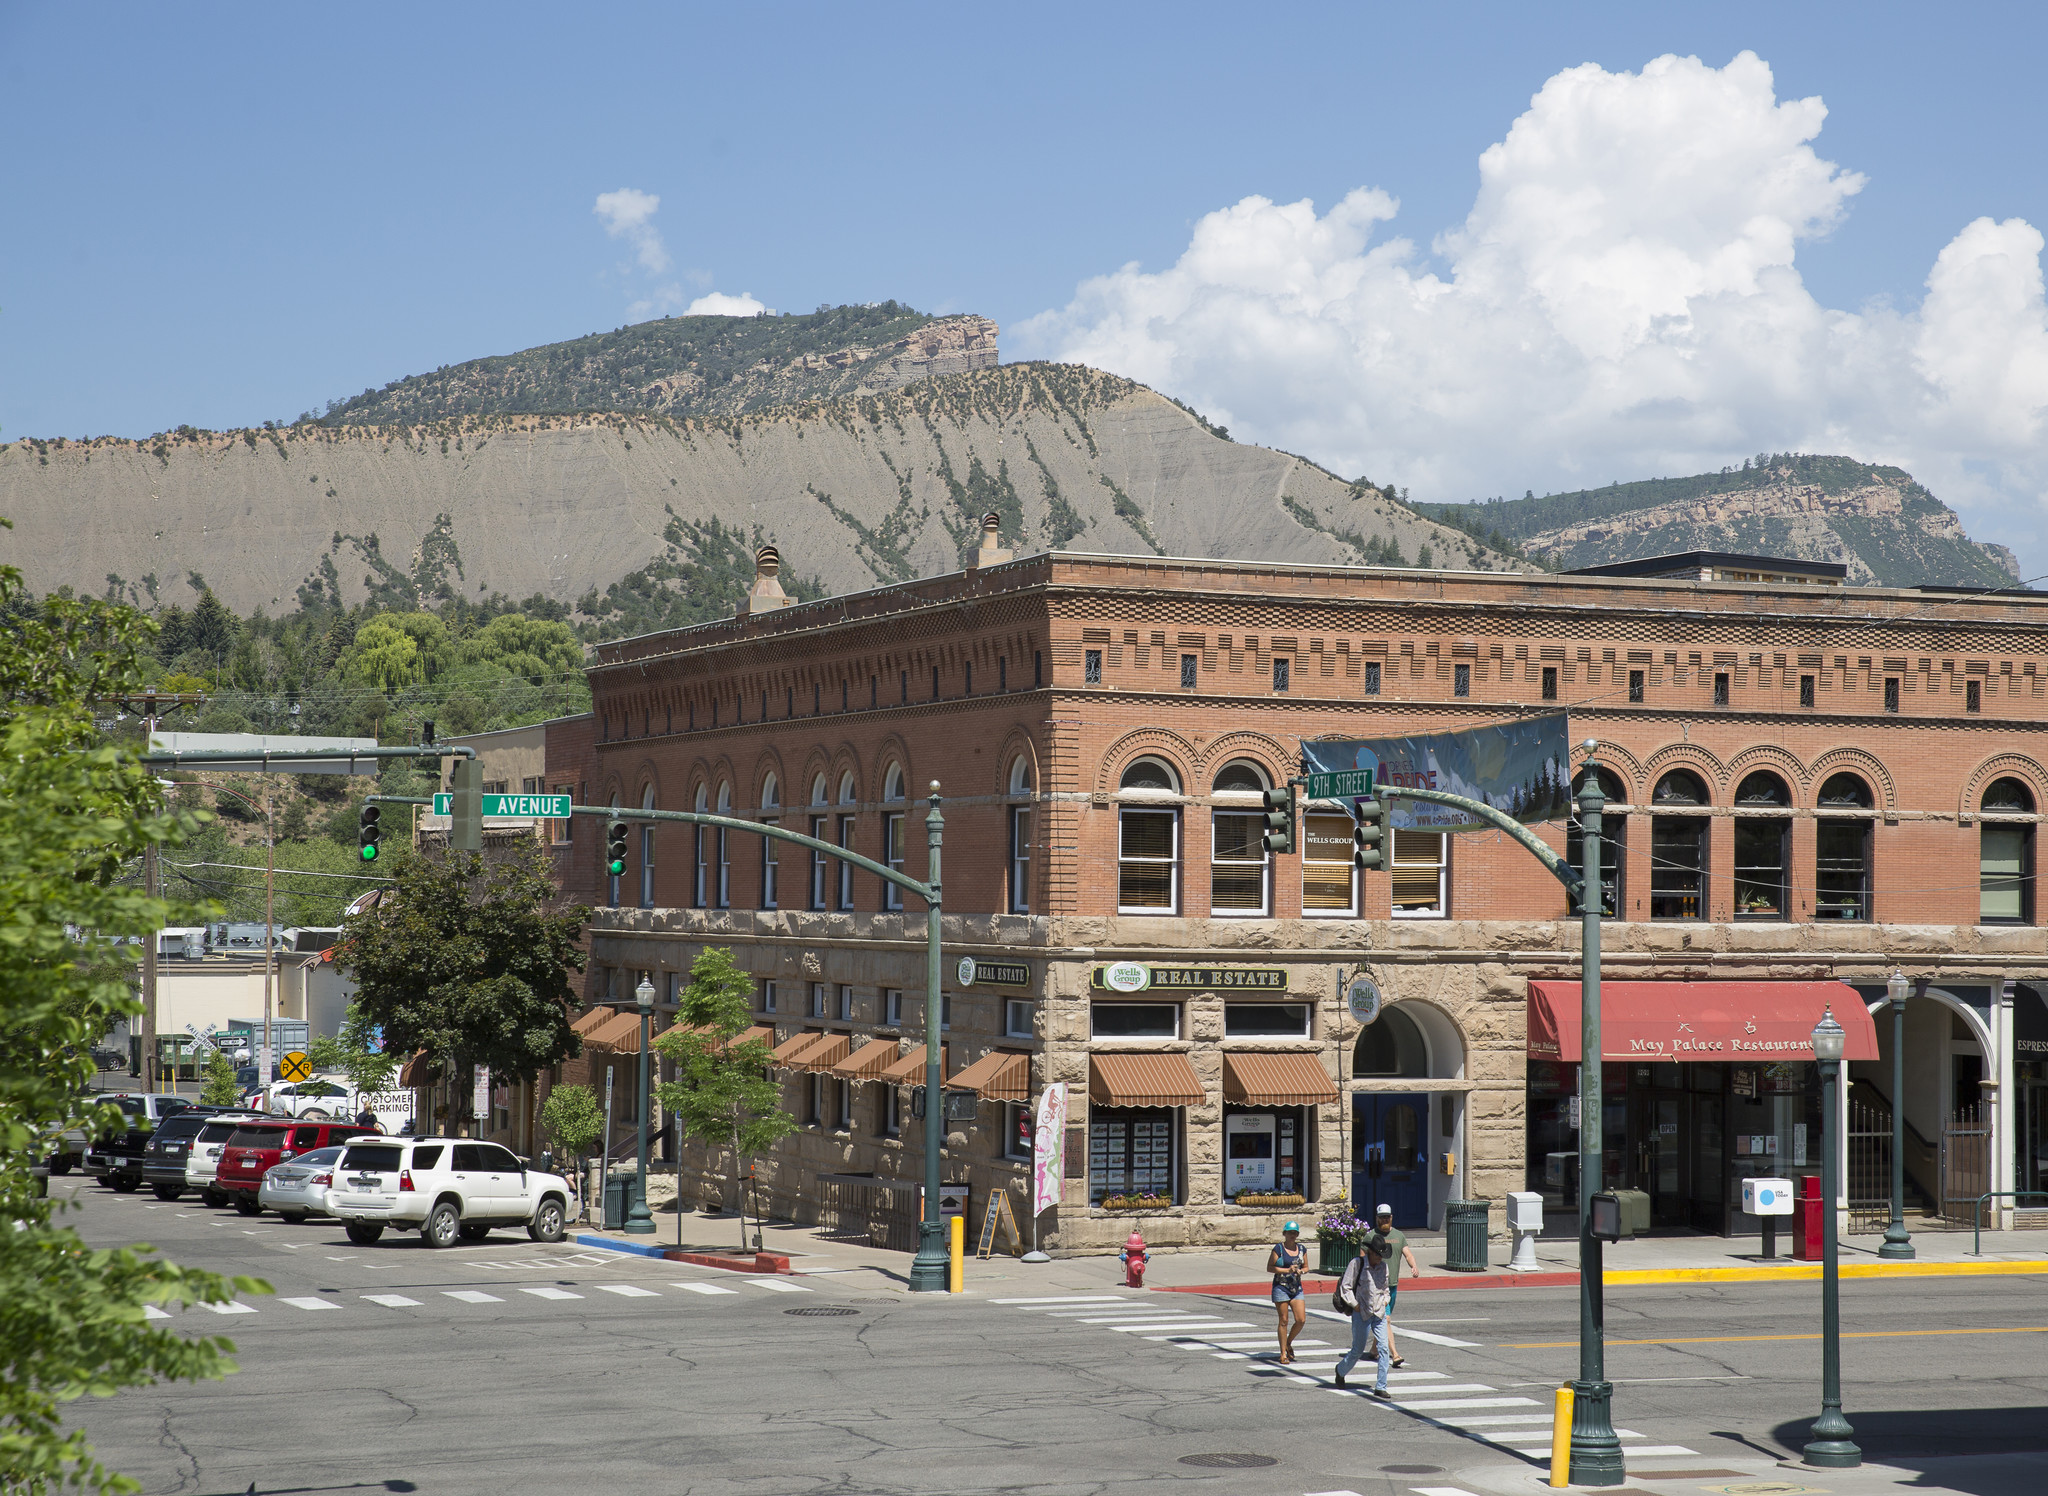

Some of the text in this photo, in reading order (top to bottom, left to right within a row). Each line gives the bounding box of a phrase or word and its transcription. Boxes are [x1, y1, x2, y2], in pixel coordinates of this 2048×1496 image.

[1313, 777, 1330, 796] 9TH
[1336, 772, 1368, 794] STREET
[497, 797, 562, 815] AVENUE
[977, 966, 1025, 982] REAL ESTATE
[1116, 967, 1141, 976] Wells
[1156, 970, 1280, 986] REAL ESTATE
[1114, 975, 1141, 984] Group
[1354, 986, 1374, 999] Wells
[1352, 998, 1374, 1012] Group
[185, 1023, 199, 1038] RAIL
[185, 1023, 217, 1053] CROSSING
[1630, 1037, 1814, 1054] May Palace Restaurant
[282, 1063, 289, 1072] R
[303, 1063, 310, 1072] R
[372, 1103, 410, 1113] ARKING
[1661, 1125, 1676, 1133] OPEN
